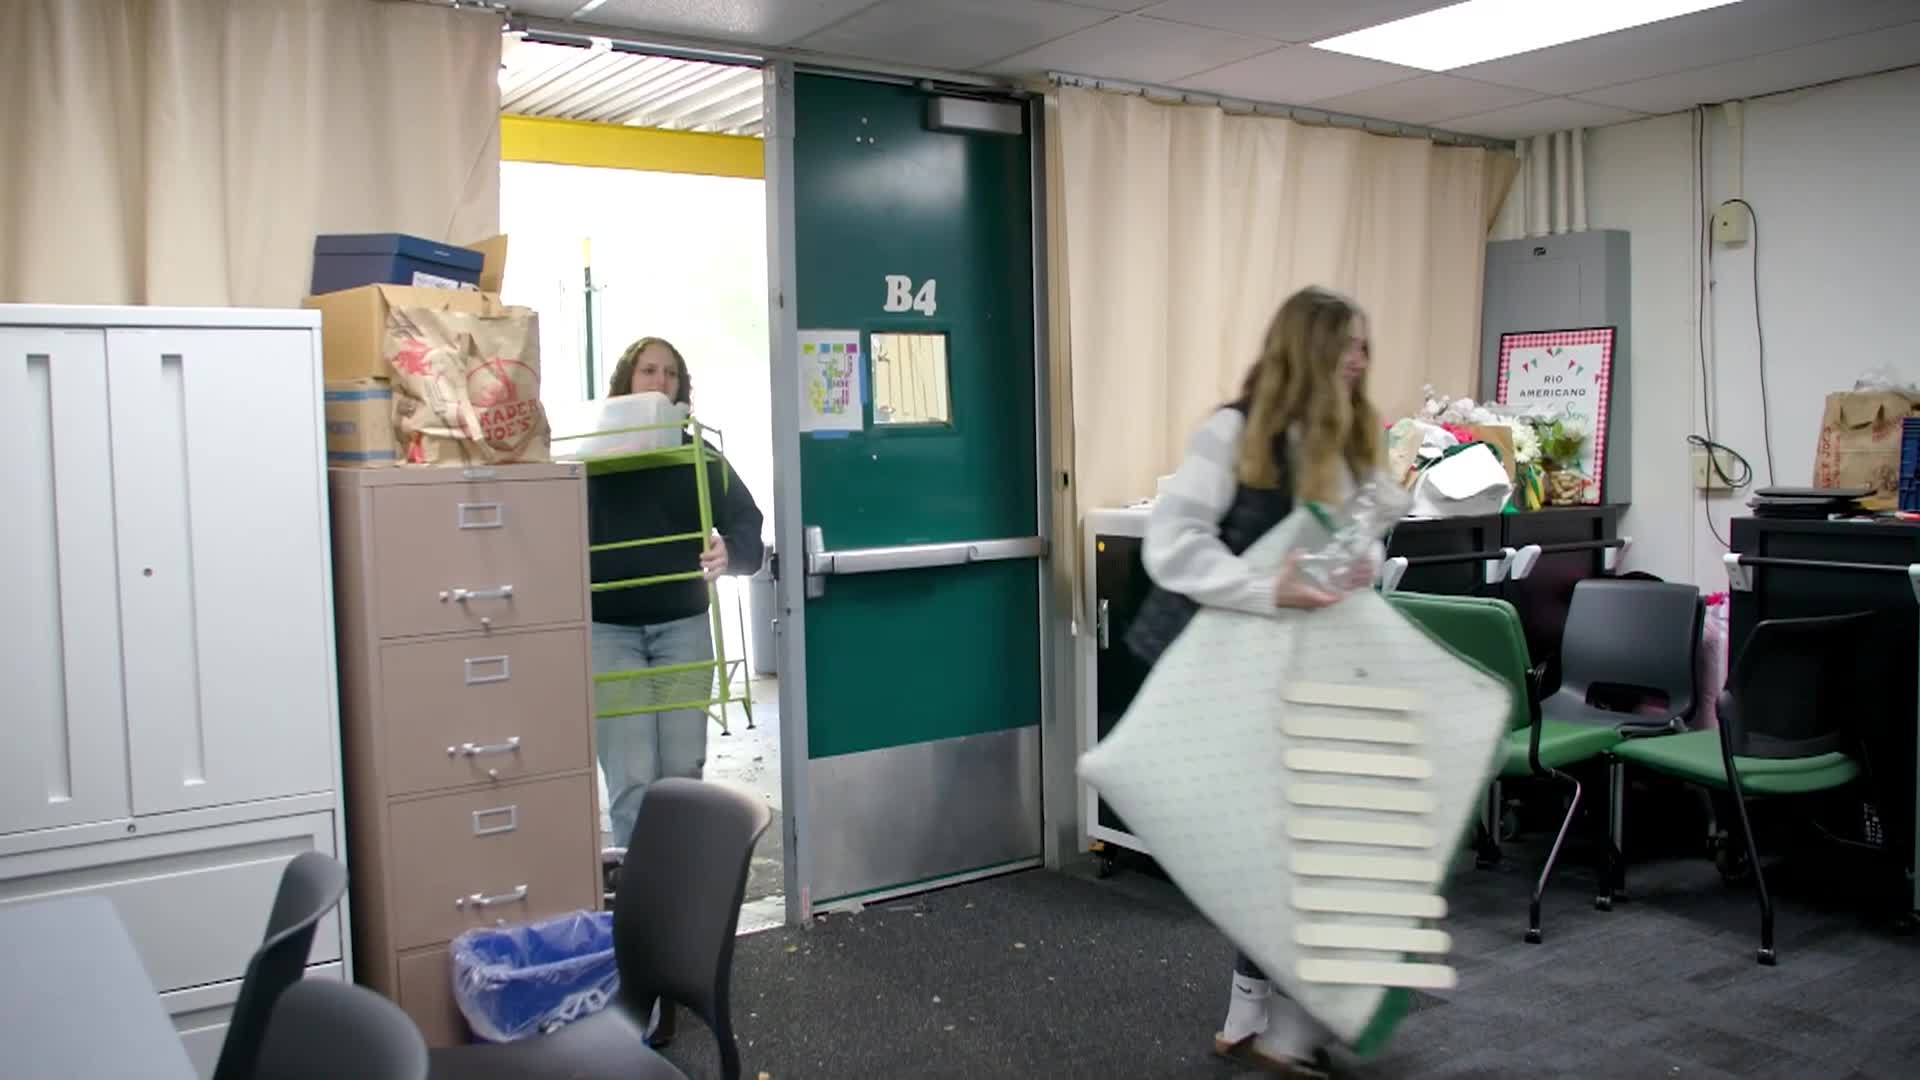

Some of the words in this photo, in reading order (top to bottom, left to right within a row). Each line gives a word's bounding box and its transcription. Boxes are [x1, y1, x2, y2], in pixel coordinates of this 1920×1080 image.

[883, 274, 937, 316] B4
[1543, 375, 1563, 384] RIO
[1519, 388, 1586, 398] AMERICANO
